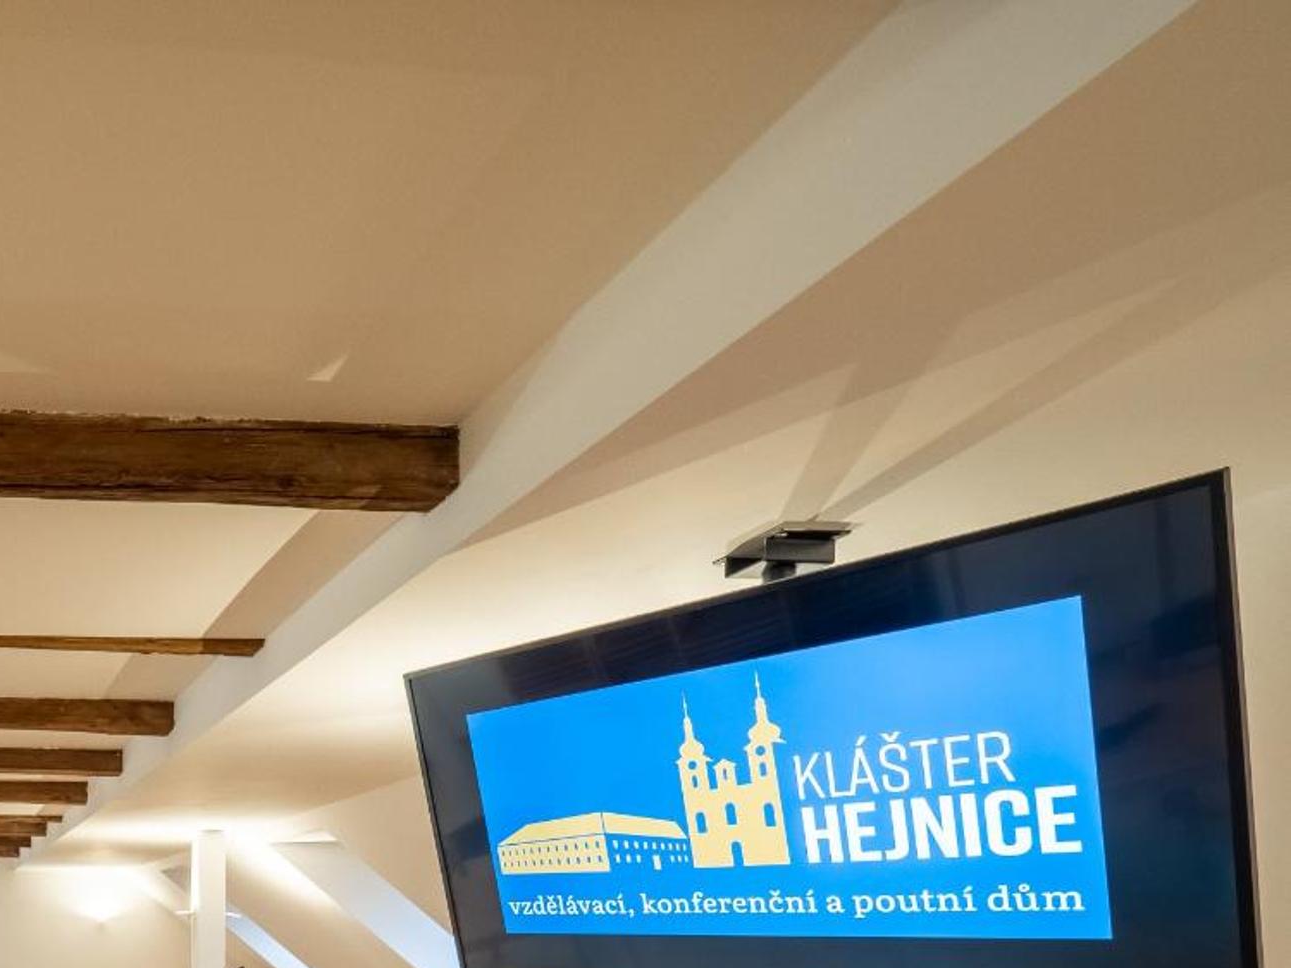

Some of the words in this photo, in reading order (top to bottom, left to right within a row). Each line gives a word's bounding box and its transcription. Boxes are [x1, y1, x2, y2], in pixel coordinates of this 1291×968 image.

[792, 730, 1016, 801] KLÁŠTER
[801, 784, 1083, 864] HEJNICE
[509, 892, 635, 918] vzdělávací,
[640, 888, 819, 915] konferenční
[825, 895, 845, 914] a
[852, 885, 978, 919] poutní
[987, 883, 1086, 912] dům
